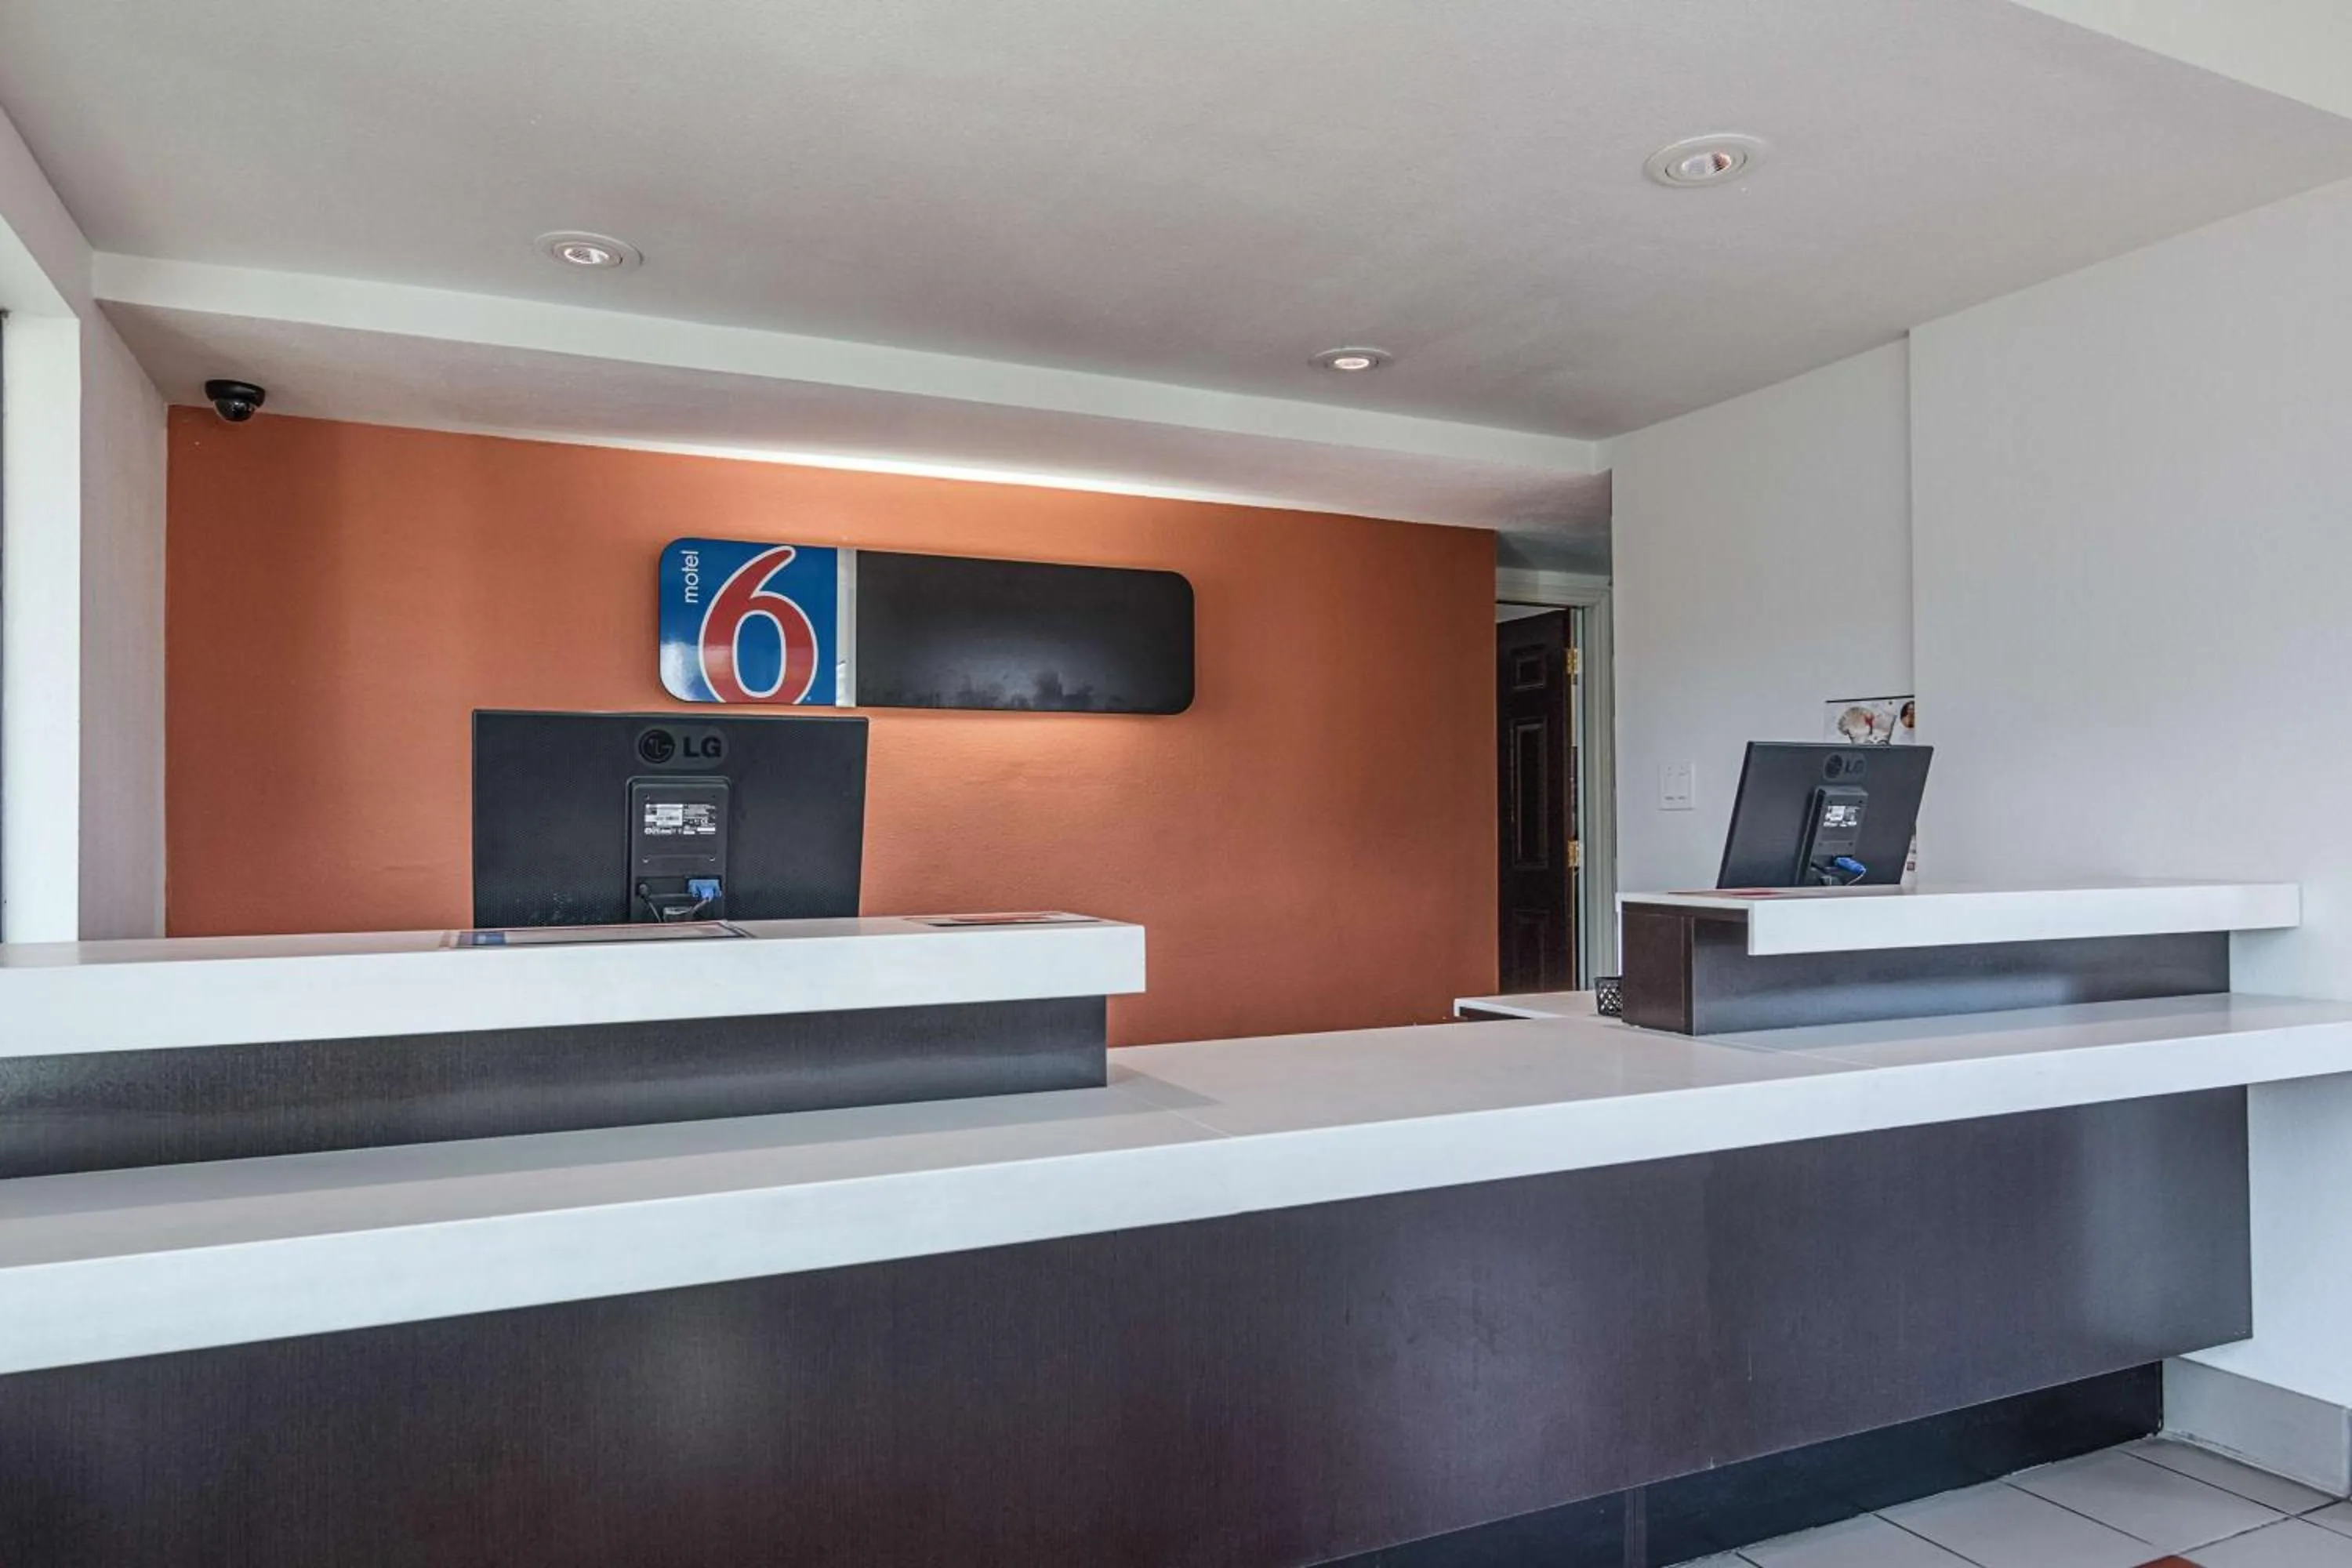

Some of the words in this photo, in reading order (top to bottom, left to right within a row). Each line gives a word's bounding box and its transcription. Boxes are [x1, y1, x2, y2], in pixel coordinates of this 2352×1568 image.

[680, 550, 699, 604] motel
[698, 545, 818, 705] 6
[683, 736, 721, 758] LG
[1845, 758, 1865, 775] LG
